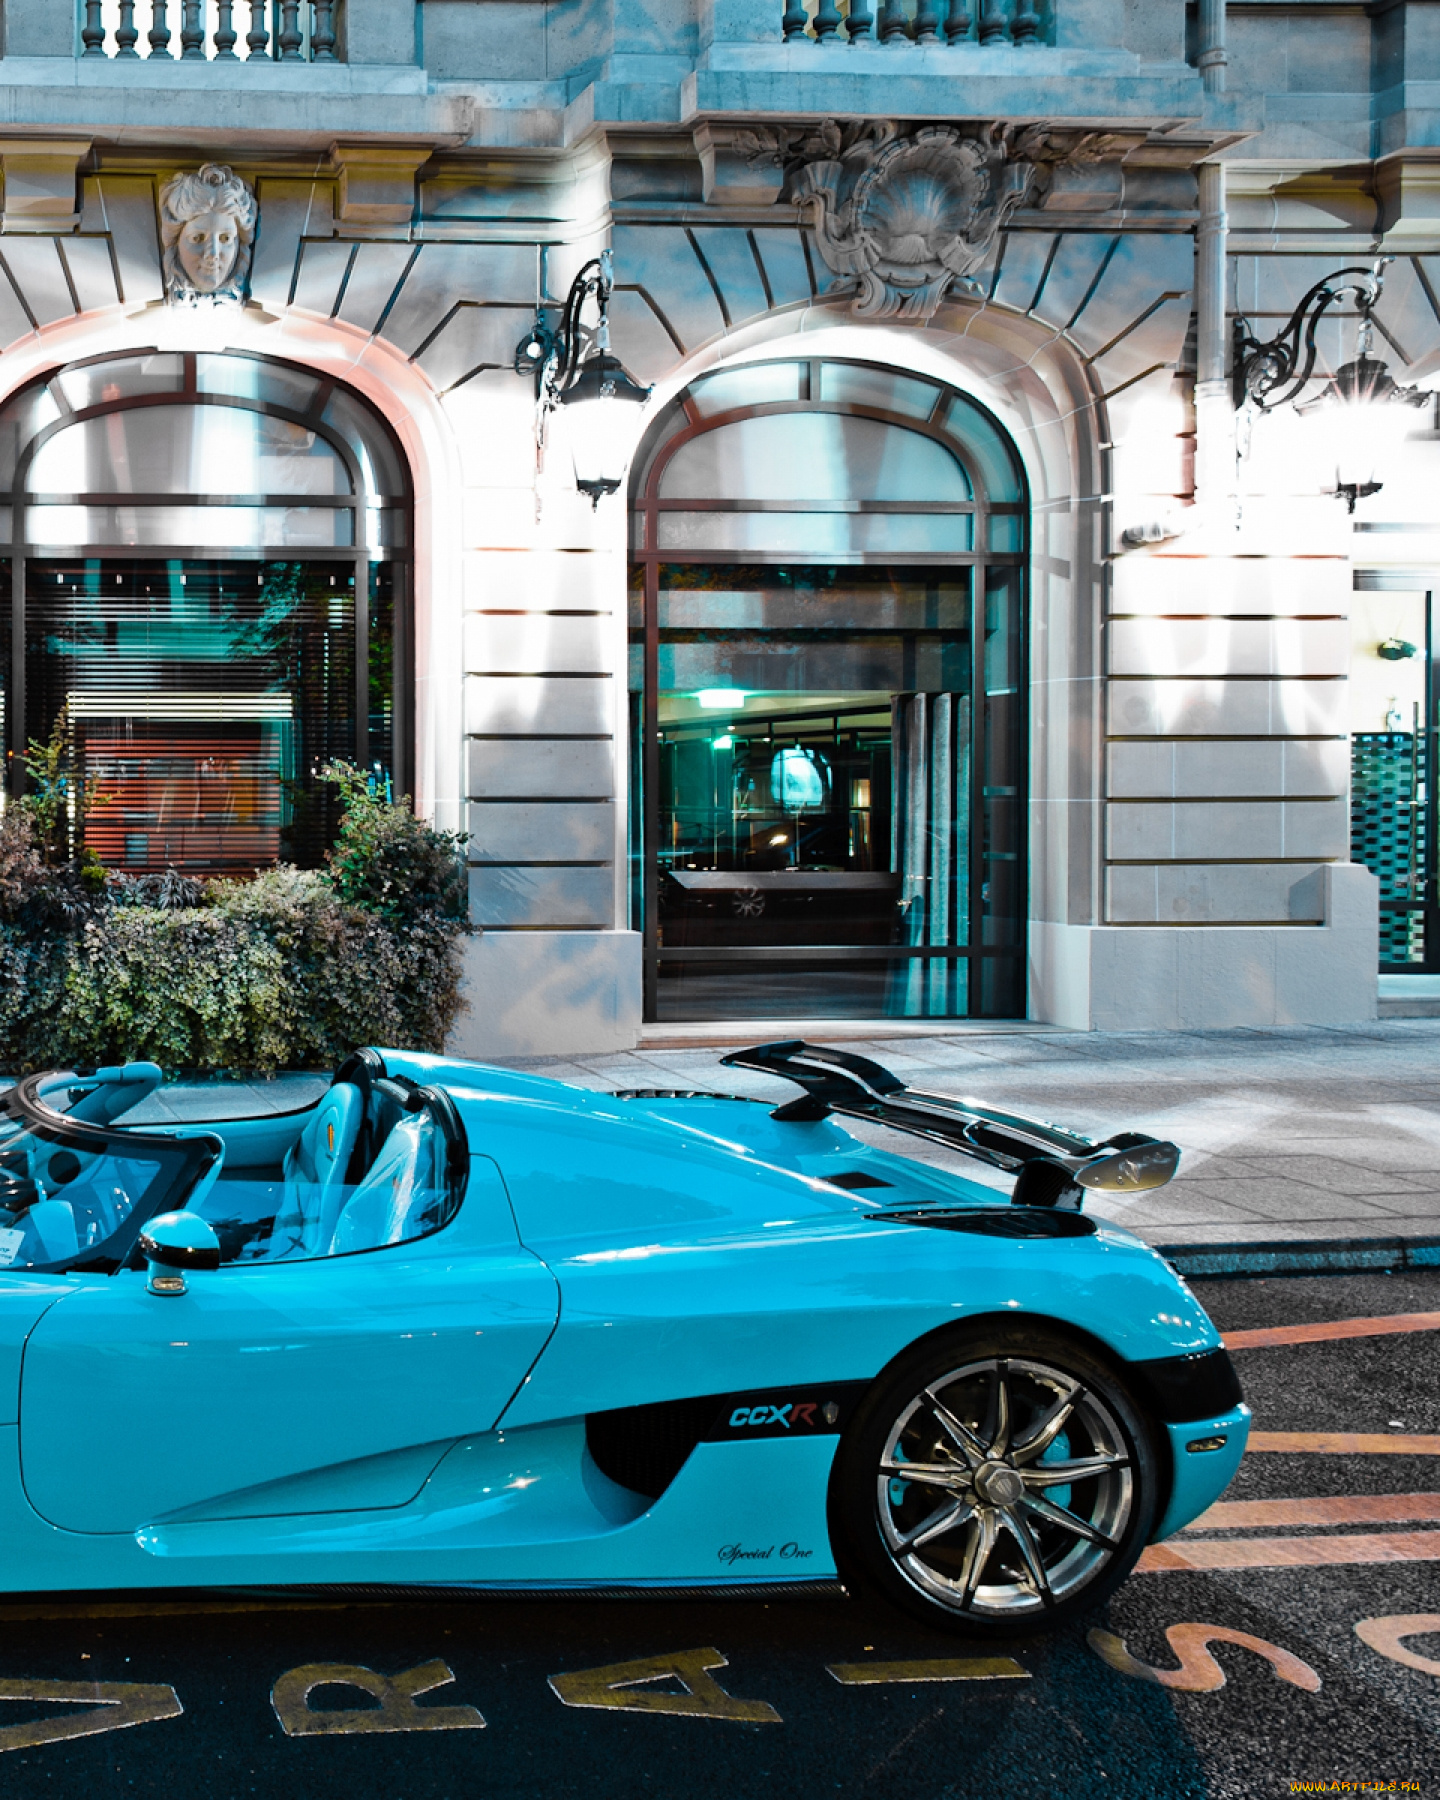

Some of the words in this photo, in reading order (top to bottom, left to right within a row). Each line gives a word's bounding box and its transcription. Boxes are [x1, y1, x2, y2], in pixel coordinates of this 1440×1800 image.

[729, 1403, 817, 1428] CCXR
[718, 1542, 775, 1566] Special
[779, 1541, 813, 1559] One
